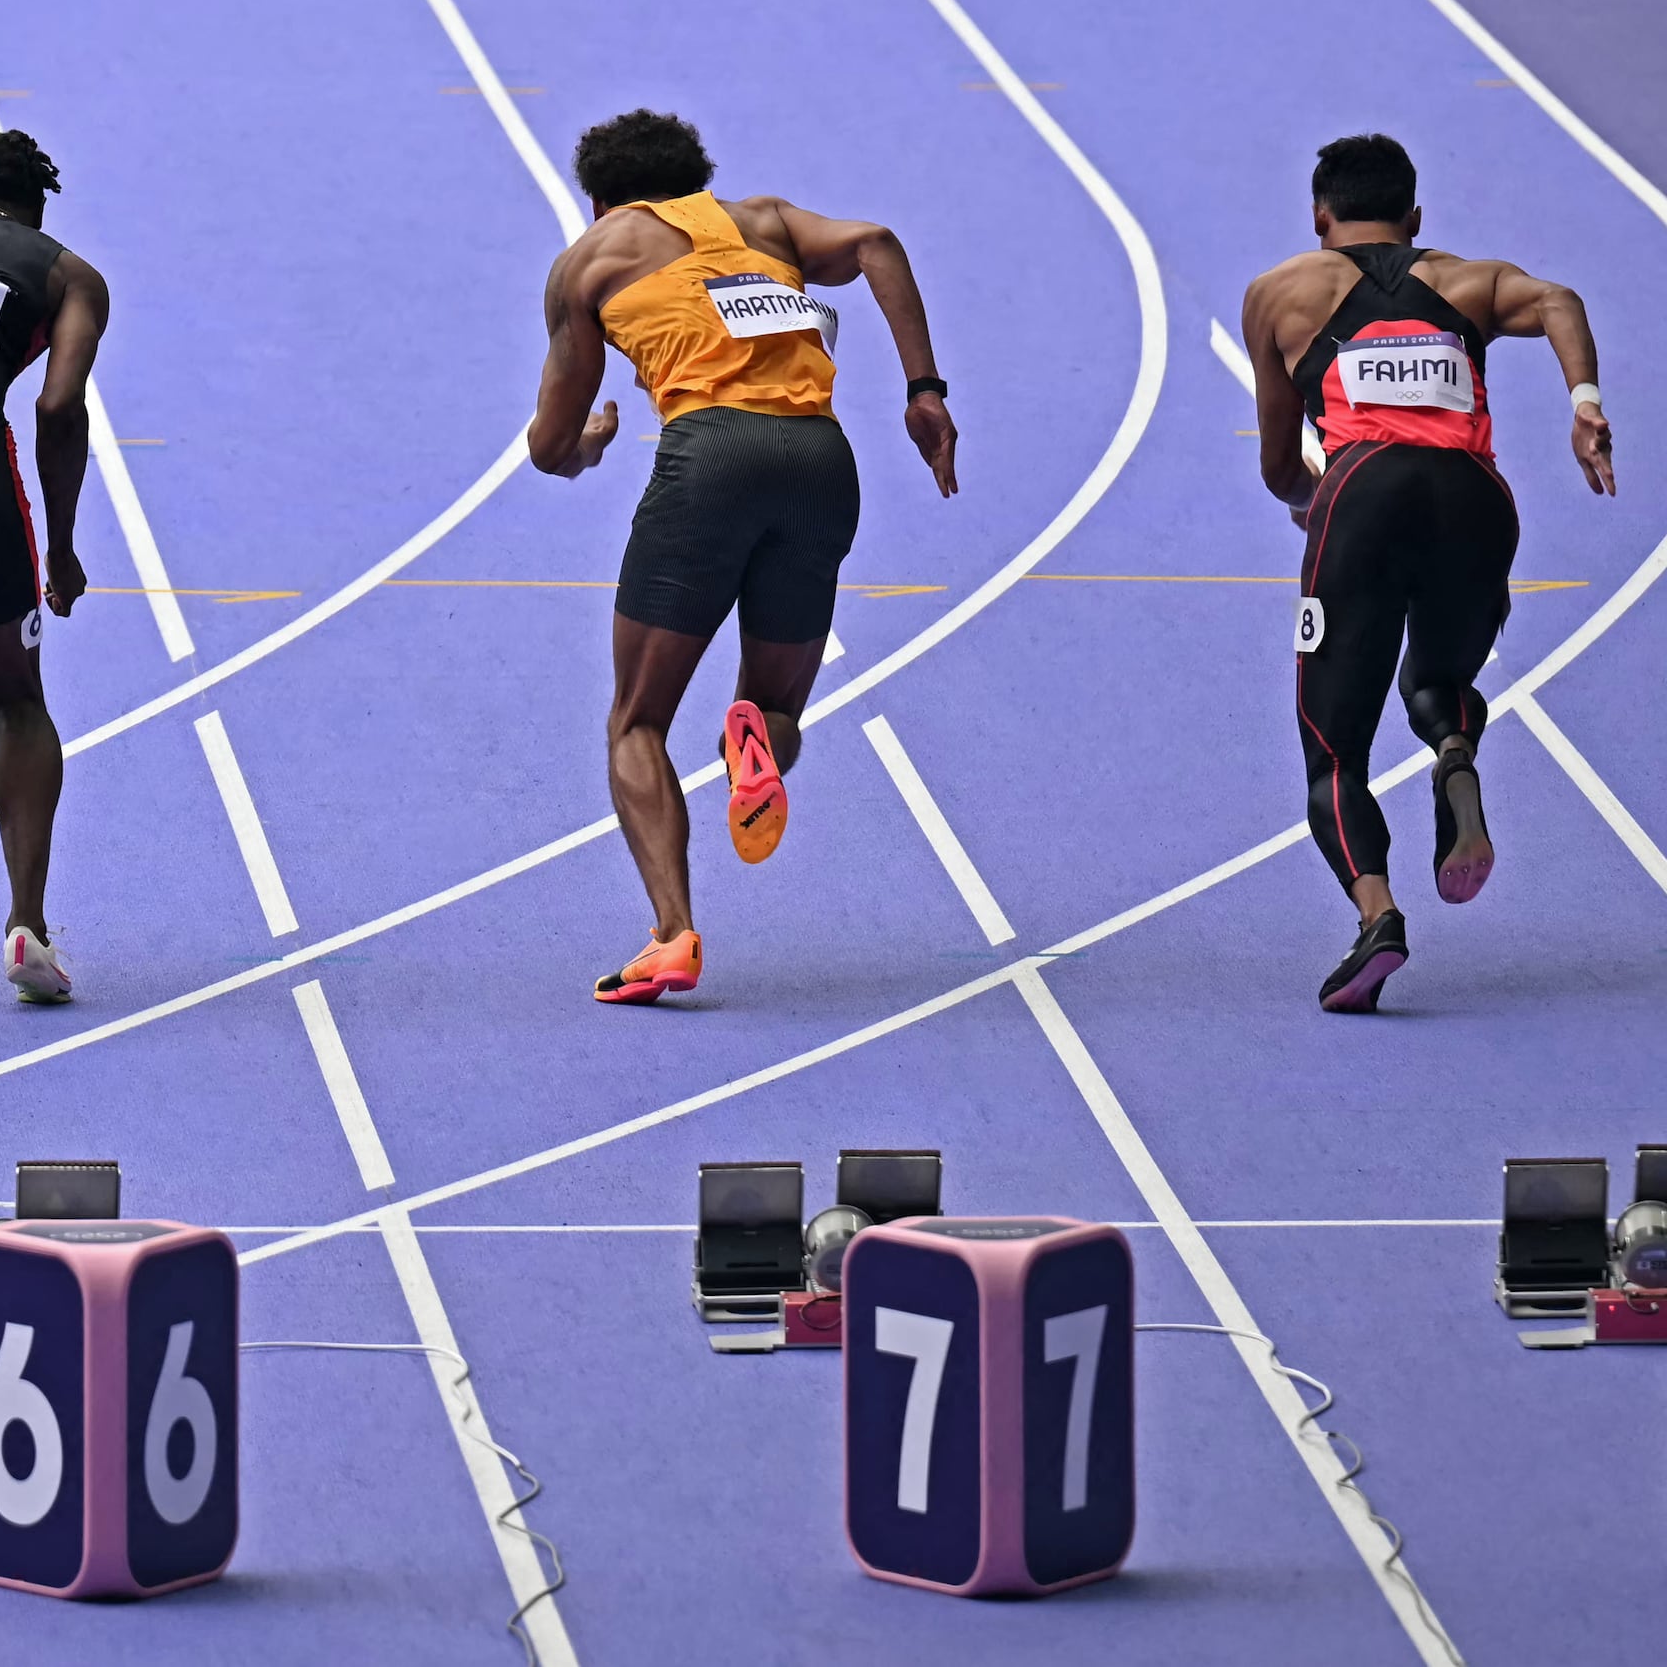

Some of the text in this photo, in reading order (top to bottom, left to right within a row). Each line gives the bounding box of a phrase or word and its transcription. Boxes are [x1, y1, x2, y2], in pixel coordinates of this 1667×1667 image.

[717, 295, 838, 323] HARTMANN
[1373, 336, 1442, 345] PARIS 2024
[1358, 359, 1457, 386] FAHMI
[1301, 608, 1315, 641] 8
[144, 1320, 217, 1525] 6
[875, 1306, 955, 1515] 7
[1044, 1304, 1109, 1513] 7
